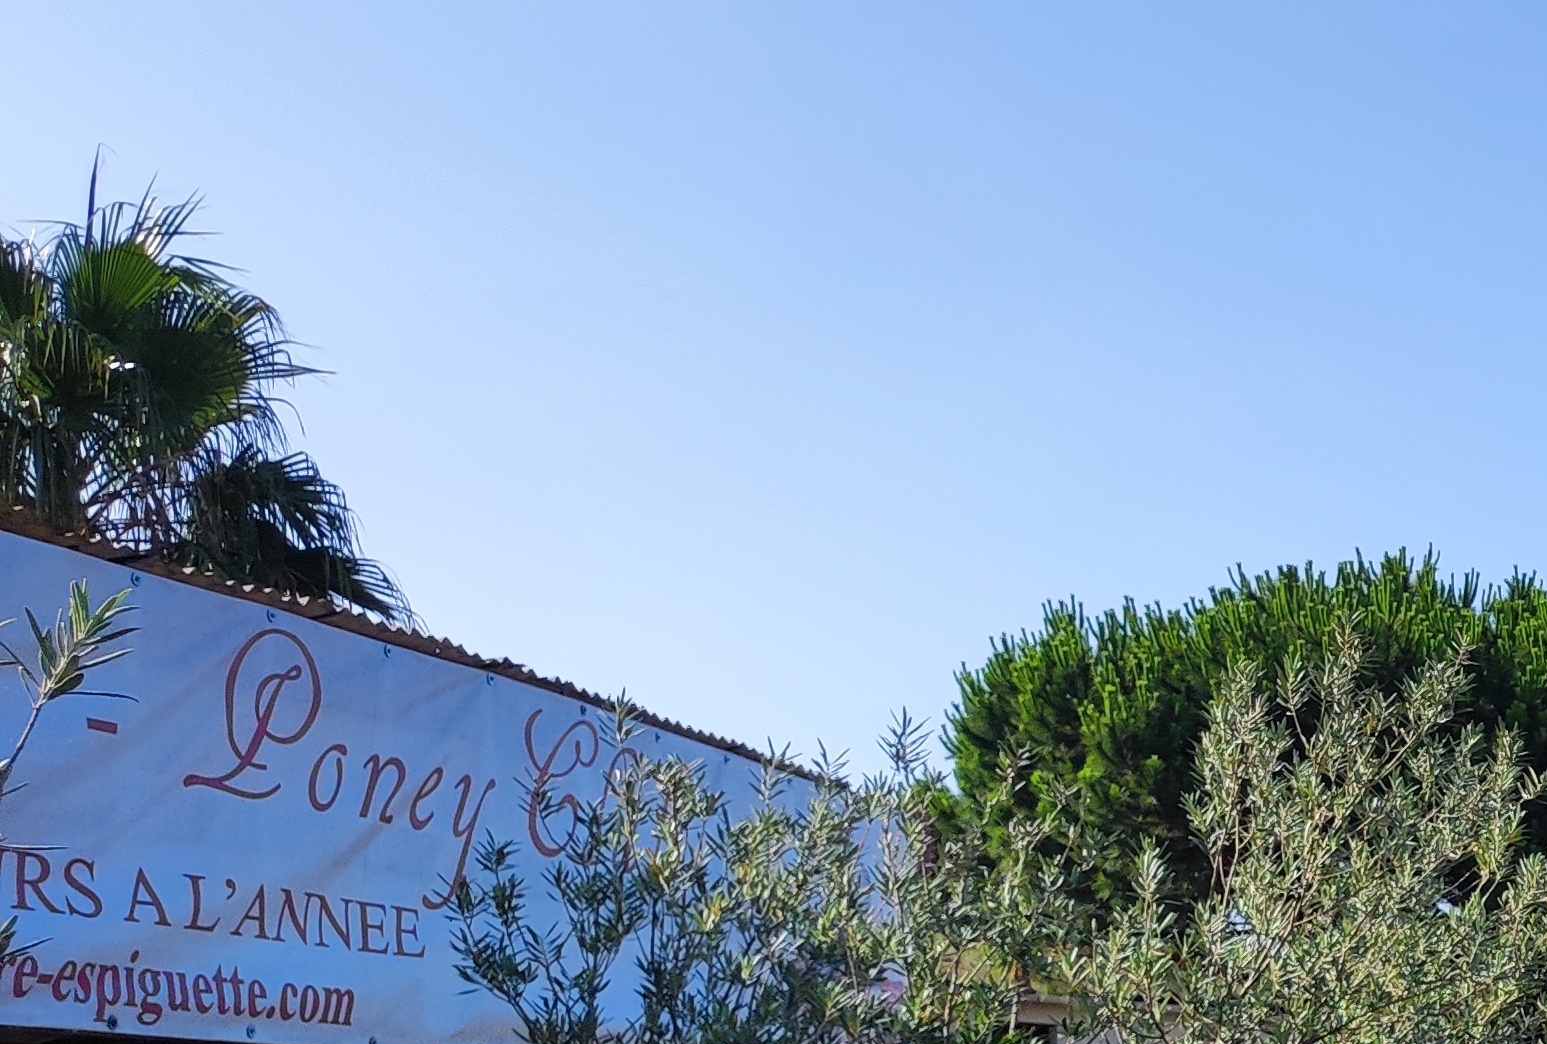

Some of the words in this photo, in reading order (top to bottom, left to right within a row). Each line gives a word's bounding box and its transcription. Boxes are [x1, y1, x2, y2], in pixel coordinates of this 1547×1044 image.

[183, 628, 496, 910] Poney
[0, 847, 104, 919] RS
[123, 866, 172, 927] A
[0, 949, 355, 1027] e-espiguette.com
